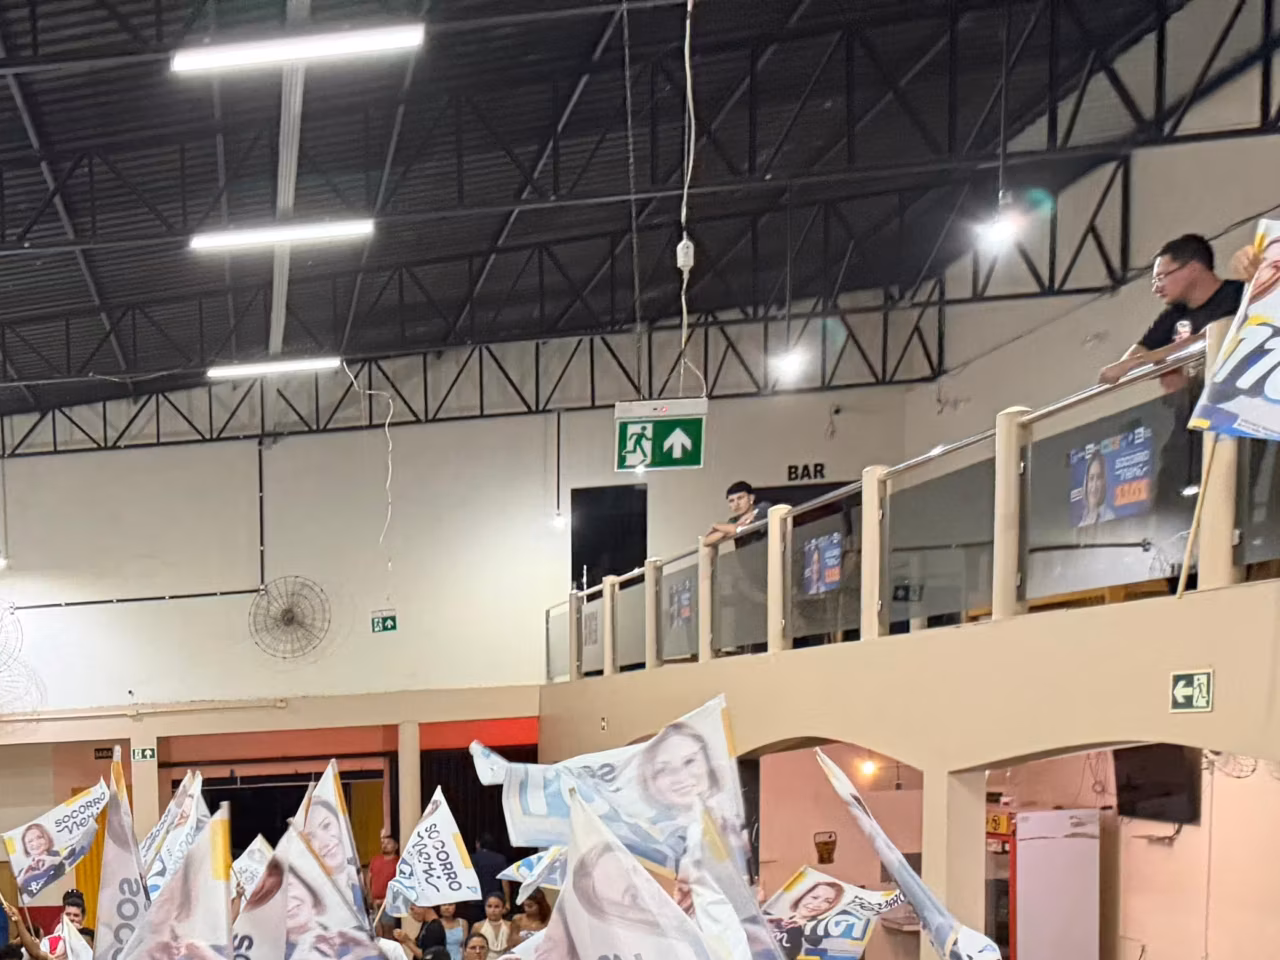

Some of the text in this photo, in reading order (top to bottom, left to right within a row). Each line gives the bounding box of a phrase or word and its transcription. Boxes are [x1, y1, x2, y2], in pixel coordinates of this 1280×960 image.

[787, 463, 825, 481] BAR
[54, 791, 106, 828] SOCORRO
[424, 822, 463, 892] SOCORRO
